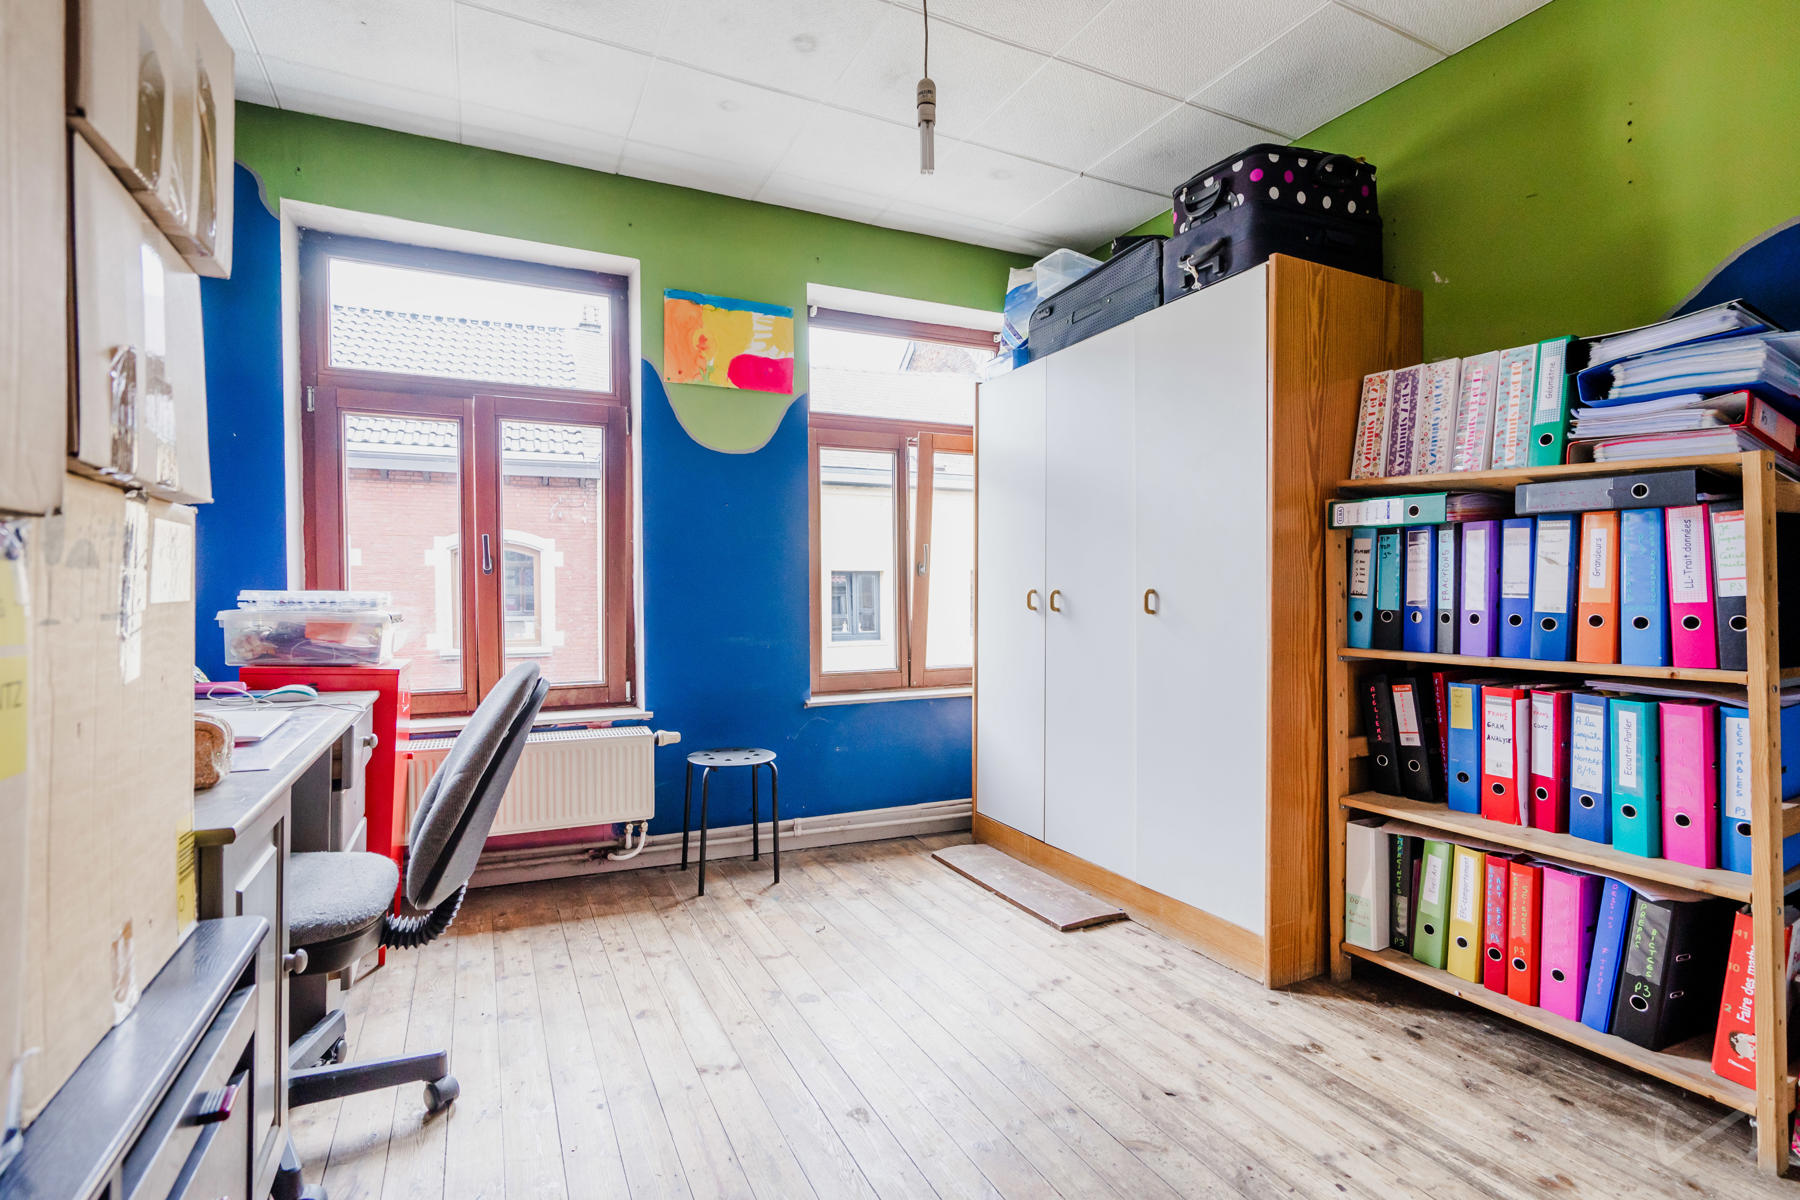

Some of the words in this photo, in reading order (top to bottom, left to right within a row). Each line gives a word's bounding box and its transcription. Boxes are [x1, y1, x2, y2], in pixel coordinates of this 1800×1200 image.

[1593, 537, 1602, 577] Grandeurs
[1441, 549, 1450, 601] FRACTIONS
[1634, 982, 1651, 998] P3
[1740, 977, 1755, 996] des
[1736, 997, 1753, 1024] Faire
